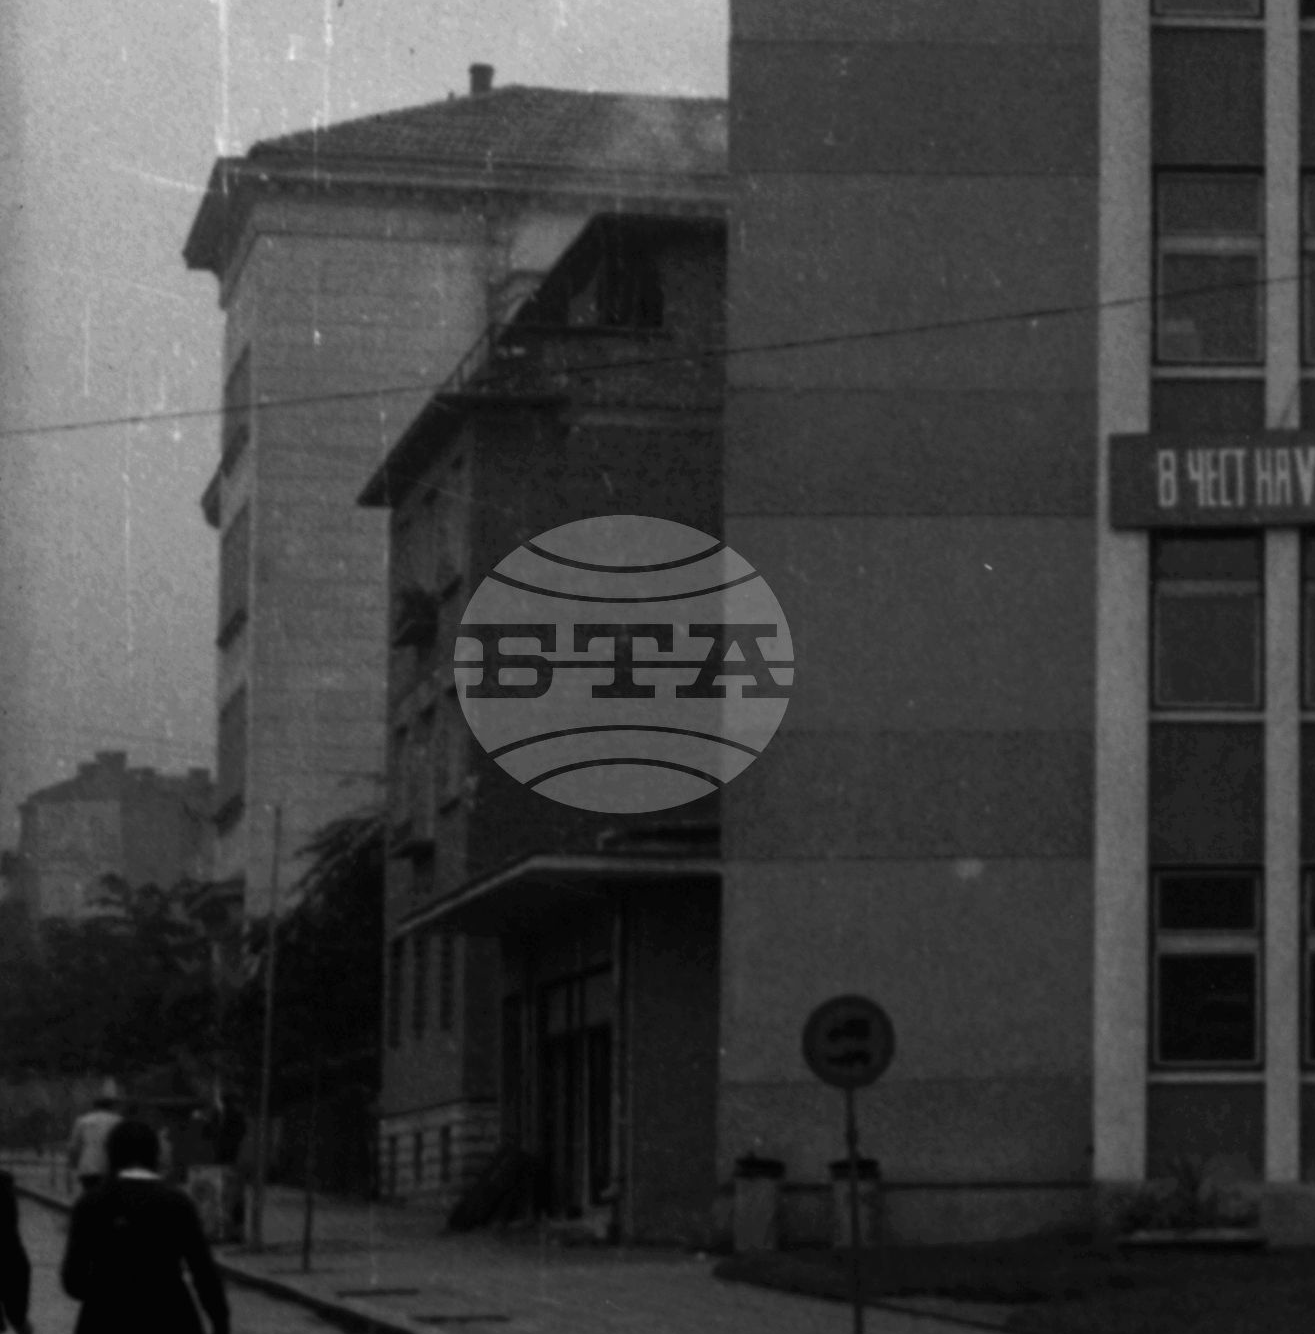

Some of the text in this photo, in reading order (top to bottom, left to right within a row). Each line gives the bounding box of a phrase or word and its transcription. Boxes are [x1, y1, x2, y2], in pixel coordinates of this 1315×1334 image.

[1157, 448, 1178, 508] В
[1186, 447, 1247, 507] ЧЕСТ
[1255, 446, 1293, 506] НА
